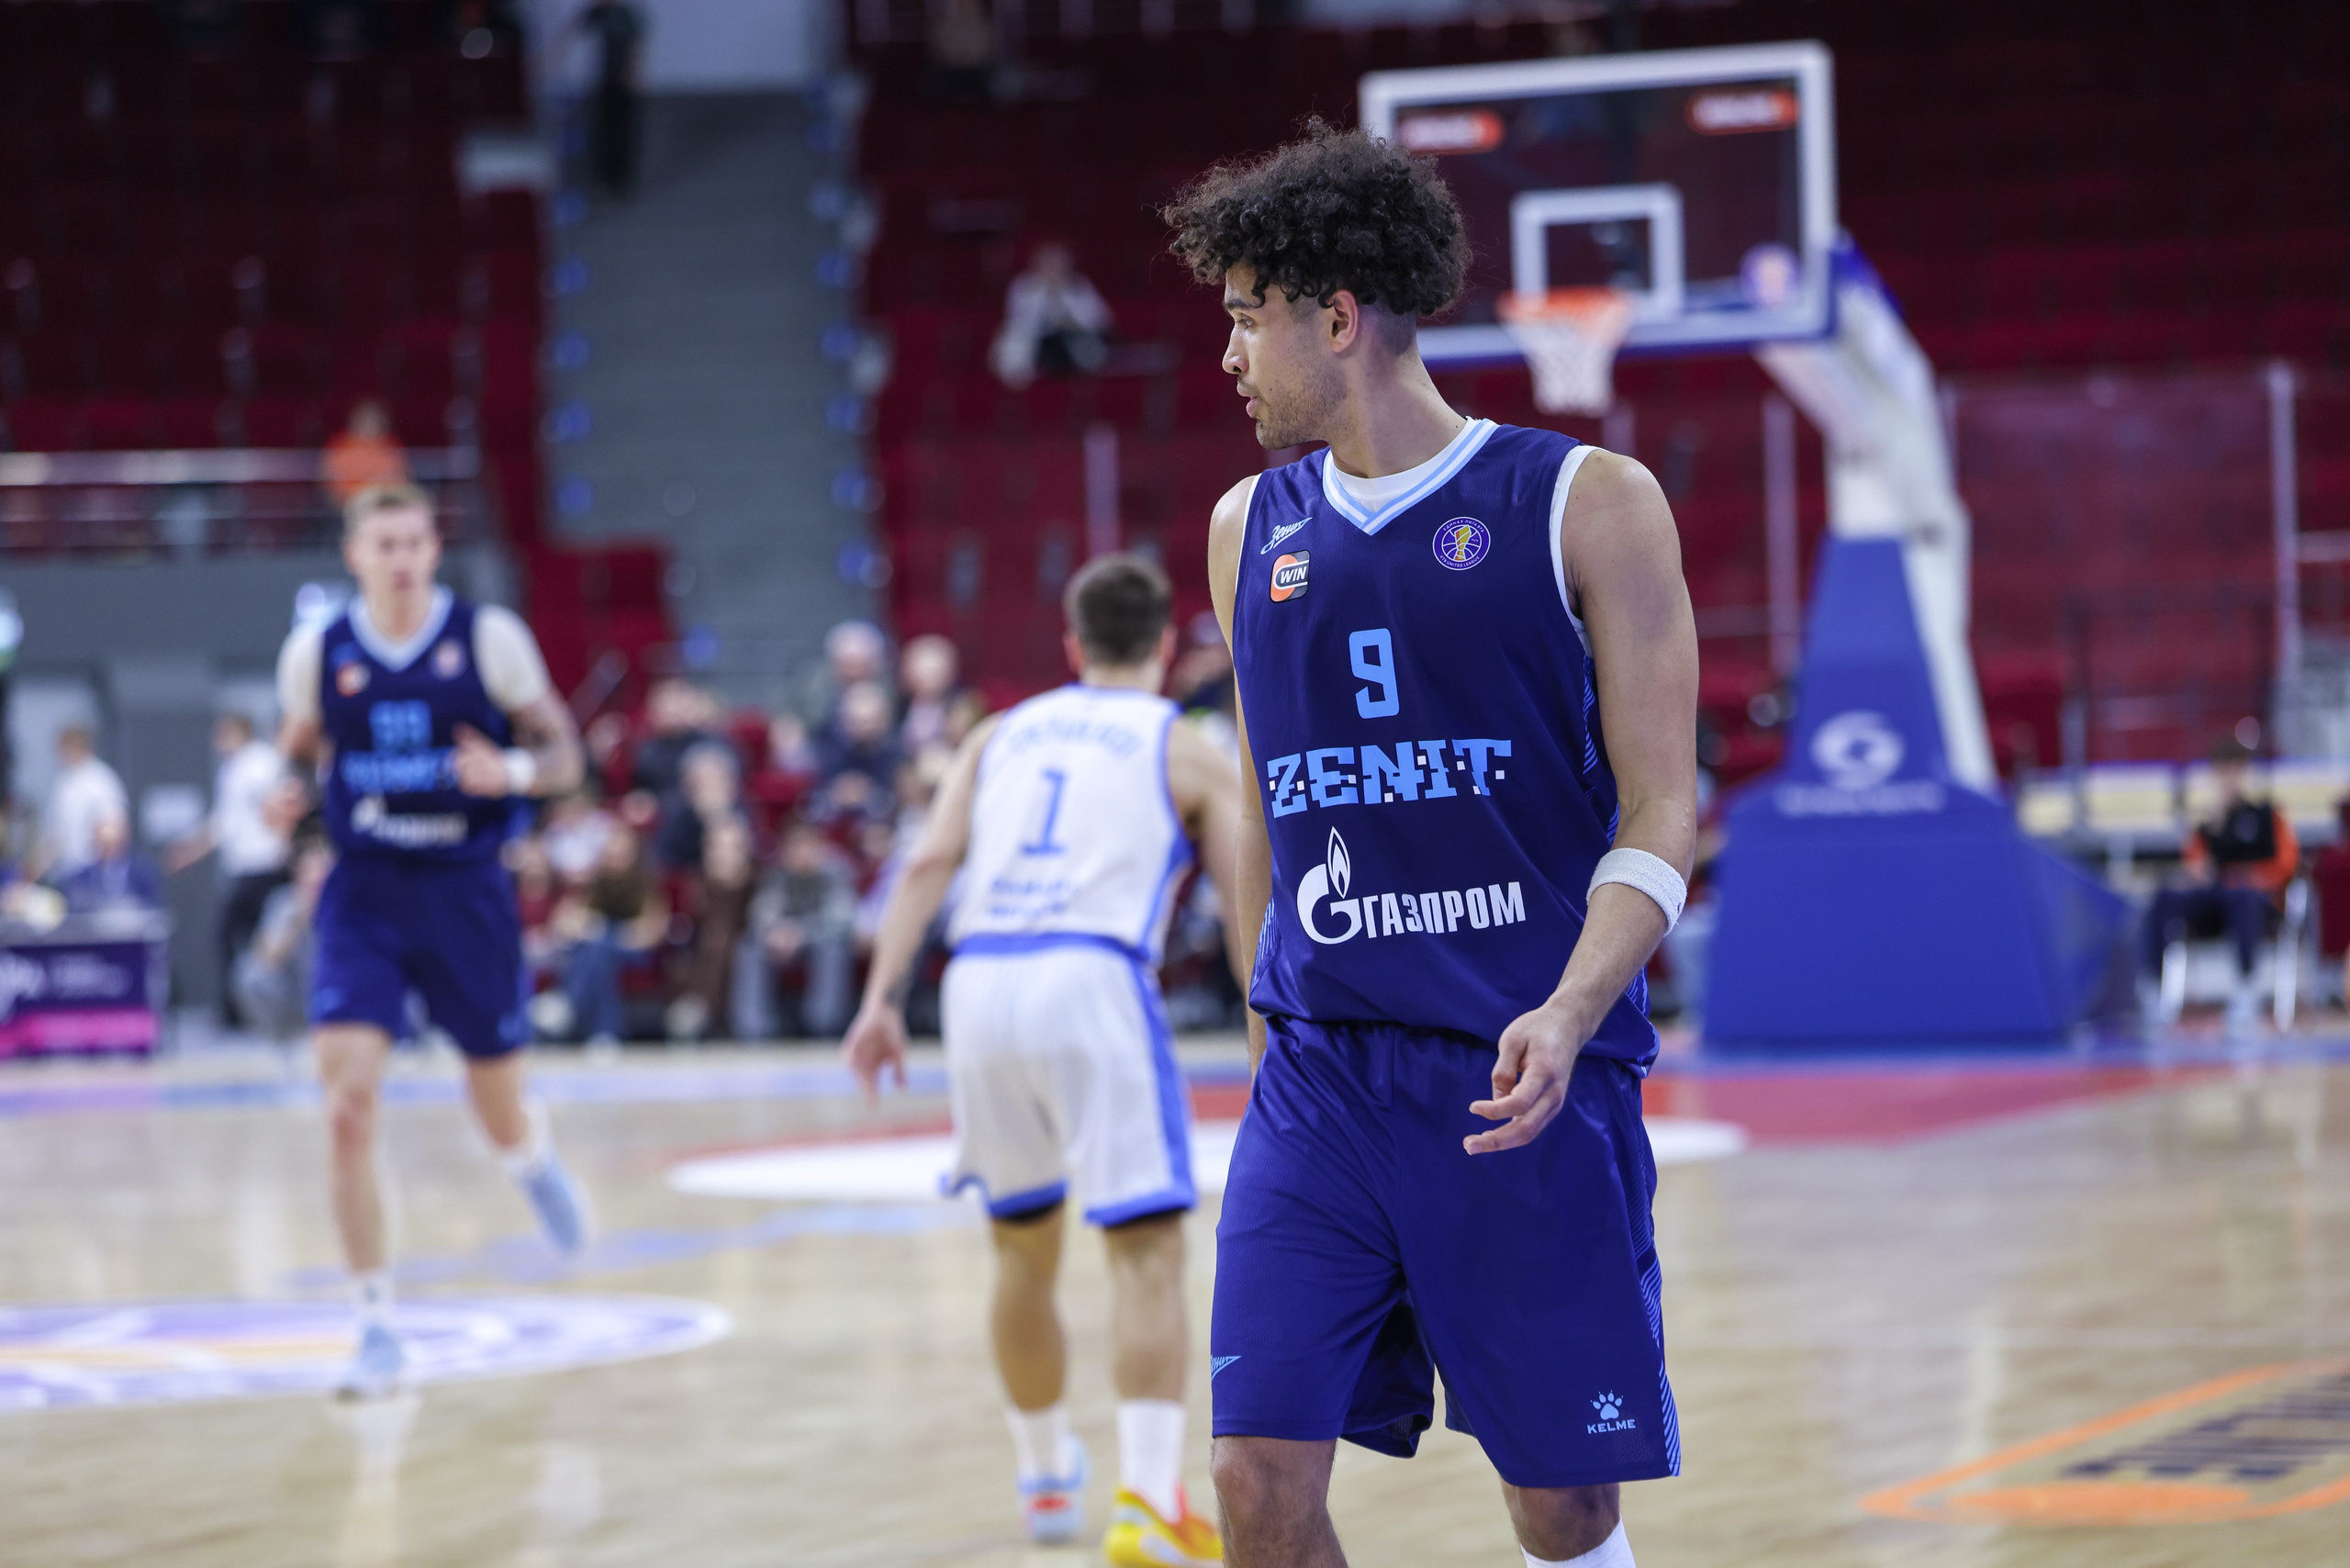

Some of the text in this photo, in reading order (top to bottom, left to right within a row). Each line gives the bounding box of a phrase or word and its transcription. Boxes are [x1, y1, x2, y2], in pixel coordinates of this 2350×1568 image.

[1280, 566, 1307, 584] WIN
[1463, 555, 1481, 566] LEAGUE
[1348, 628, 1400, 720] 9
[1267, 738, 1512, 819] ZENIT
[1021, 766, 1067, 857] 1
[1362, 881, 1526, 938] ГАЗПРОМ
[1587, 1418, 1636, 1434] KELME
